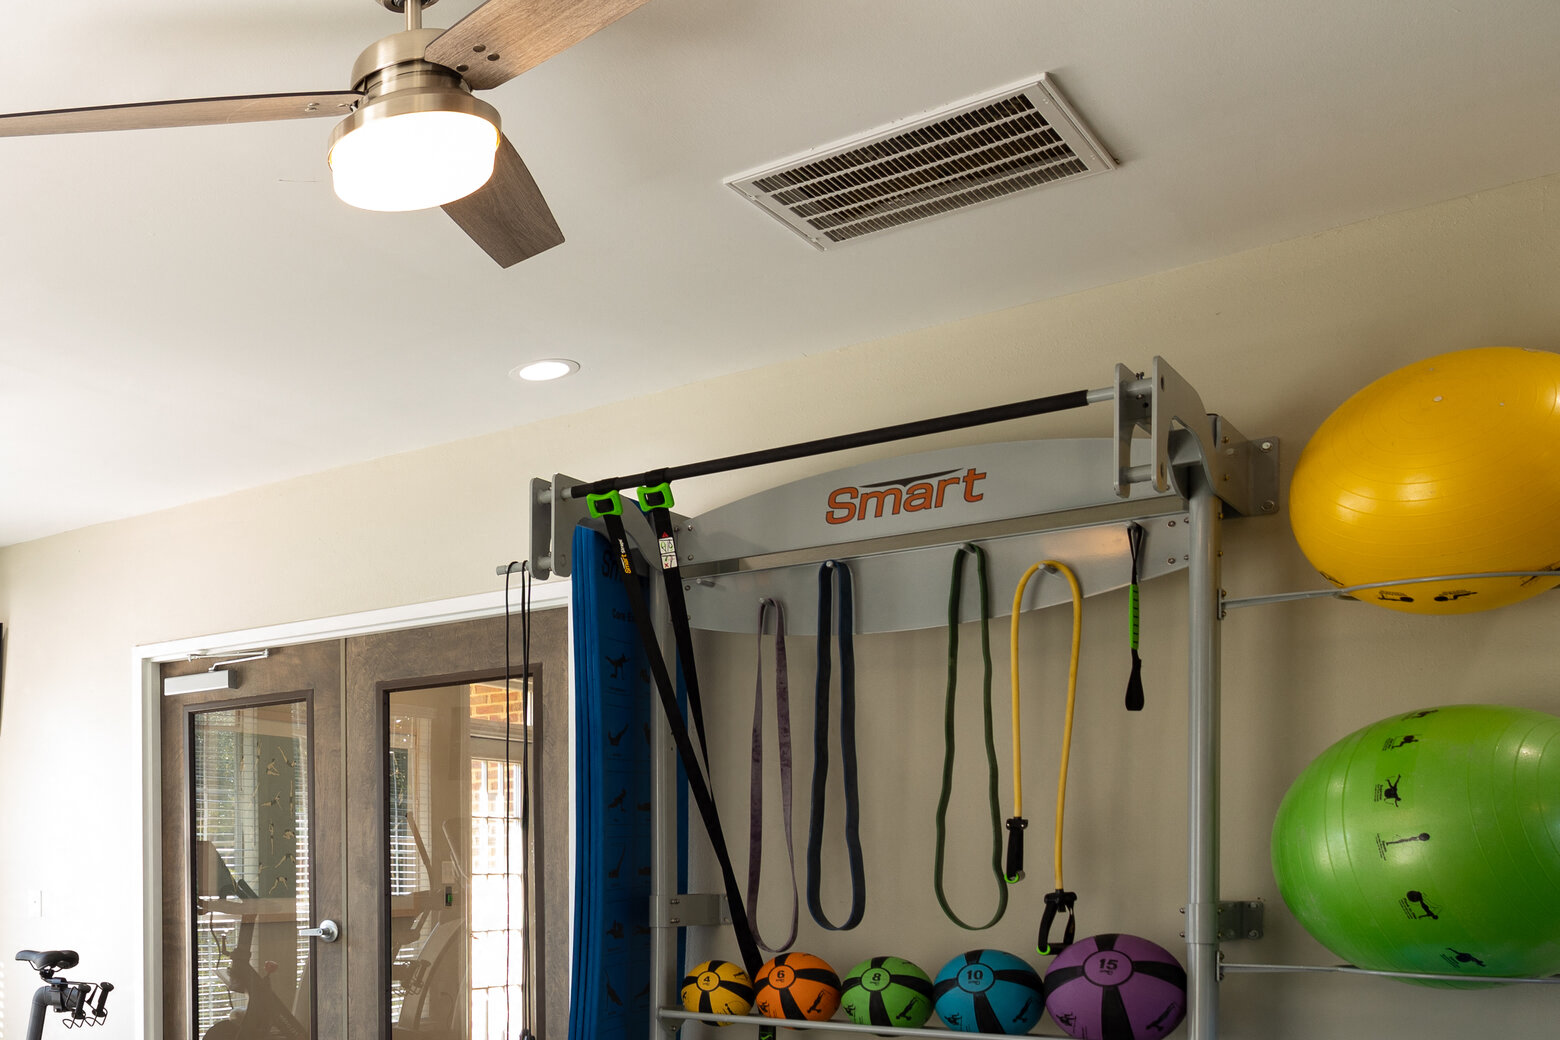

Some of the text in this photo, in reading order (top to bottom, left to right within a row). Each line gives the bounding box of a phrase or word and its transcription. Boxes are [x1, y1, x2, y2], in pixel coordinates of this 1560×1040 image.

[826, 468, 987, 525] Smart
[1099, 958, 1119, 970] 15
[703, 975, 711, 983] 4
[777, 970, 785, 979] 6
[872, 973, 882, 982] 8
[966, 969, 984, 981] 10
